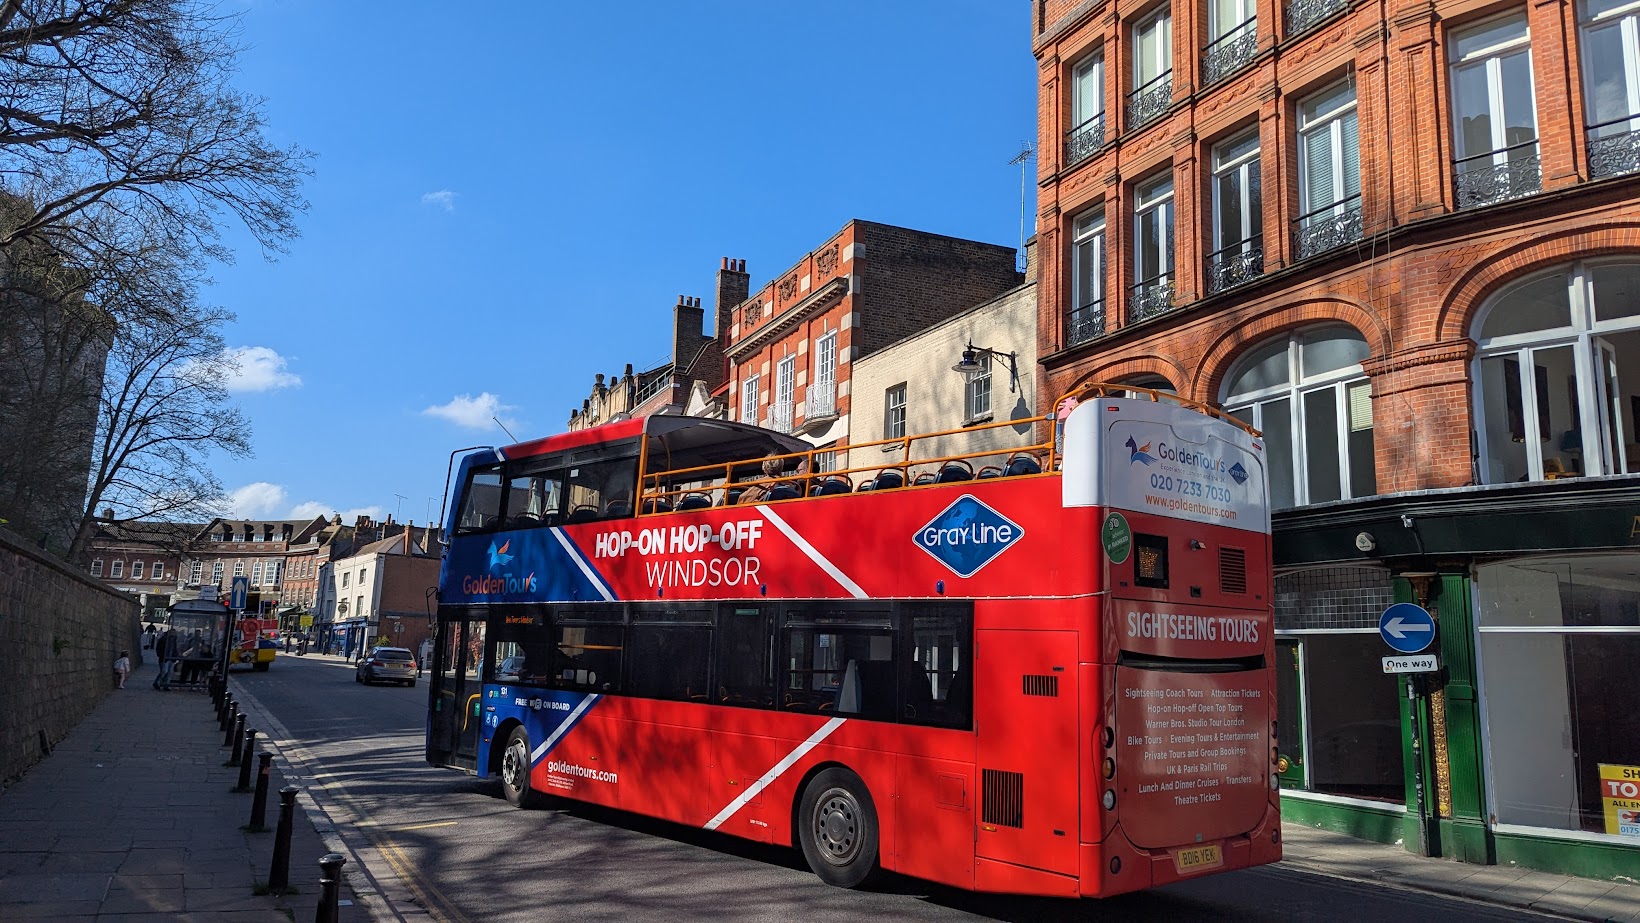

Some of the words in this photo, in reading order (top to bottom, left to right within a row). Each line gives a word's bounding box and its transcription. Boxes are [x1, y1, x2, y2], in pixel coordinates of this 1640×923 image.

[1158, 442, 1225, 473] GoldenTours
[1150, 473, 1173, 492] 020
[1176, 478, 1202, 497] 7233
[1205, 485, 1231, 503] 7030
[1145, 494, 1237, 520] www.goldentours.com
[595, 526, 666, 559] HOP-ON
[669, 520, 763, 554] HOP-OFF
[645, 556, 761, 588] WINDSOR
[463, 571, 537, 595] GoldenTours
[1127, 611, 1216, 641] SIGHTSEEING
[1218, 617, 1259, 643] TOURS
[1386, 660, 1408, 668] One
[1411, 660, 1433, 669] way
[1125, 688, 1164, 699] Sightseeing
[1165, 688, 1186, 698] Coach
[1187, 688, 1204, 698] Tours
[1211, 688, 1240, 698] Attraction
[1240, 688, 1261, 698] Tickets
[515, 697, 528, 706] FREE
[543, 701, 551, 709] ON
[551, 702, 571, 711] BOARD
[1147, 703, 1172, 714] Hop-on
[1172, 702, 1198, 714] Hop-off
[1198, 703, 1215, 714] Open
[1215, 703, 1227, 714] Top
[1227, 703, 1243, 712] Tours
[1145, 719, 1169, 729] Warner
[1170, 718, 1187, 728] Bros.
[1188, 718, 1208, 728] Studio
[1209, 718, 1223, 727] Tour
[1223, 717, 1245, 727] London
[1127, 736, 1143, 746] Bike
[1144, 736, 1162, 745] Tours
[1170, 733, 1195, 744] Evening
[1196, 733, 1213, 742] Tours
[1213, 732, 1218, 742] &
[1219, 731, 1260, 741] Entertainment
[1144, 751, 1168, 761] Private
[1169, 750, 1186, 759] Tours
[1187, 749, 1199, 758] and
[1200, 748, 1219, 759] Group
[1219, 746, 1247, 757] Bookings
[547, 760, 618, 784] goldentours.com
[1166, 765, 1176, 775] UK
[1177, 764, 1182, 774] &
[1183, 764, 1199, 773] Paris
[1199, 763, 1212, 772] Rail
[1212, 761, 1228, 773] Trips
[1138, 782, 1159, 794] Lunch
[1160, 781, 1174, 792] And
[1174, 779, 1196, 790] Dinner
[1196, 778, 1219, 788] Cruises
[1226, 775, 1252, 785] Transfers
[1607, 781, 1638, 798] TO
[1174, 795, 1199, 806] Theatre
[1199, 793, 1221, 804] Tickets
[1612, 800, 1629, 808] ALL
[1182, 850, 1200, 866] BD16
[1200, 848, 1215, 863] YEK
